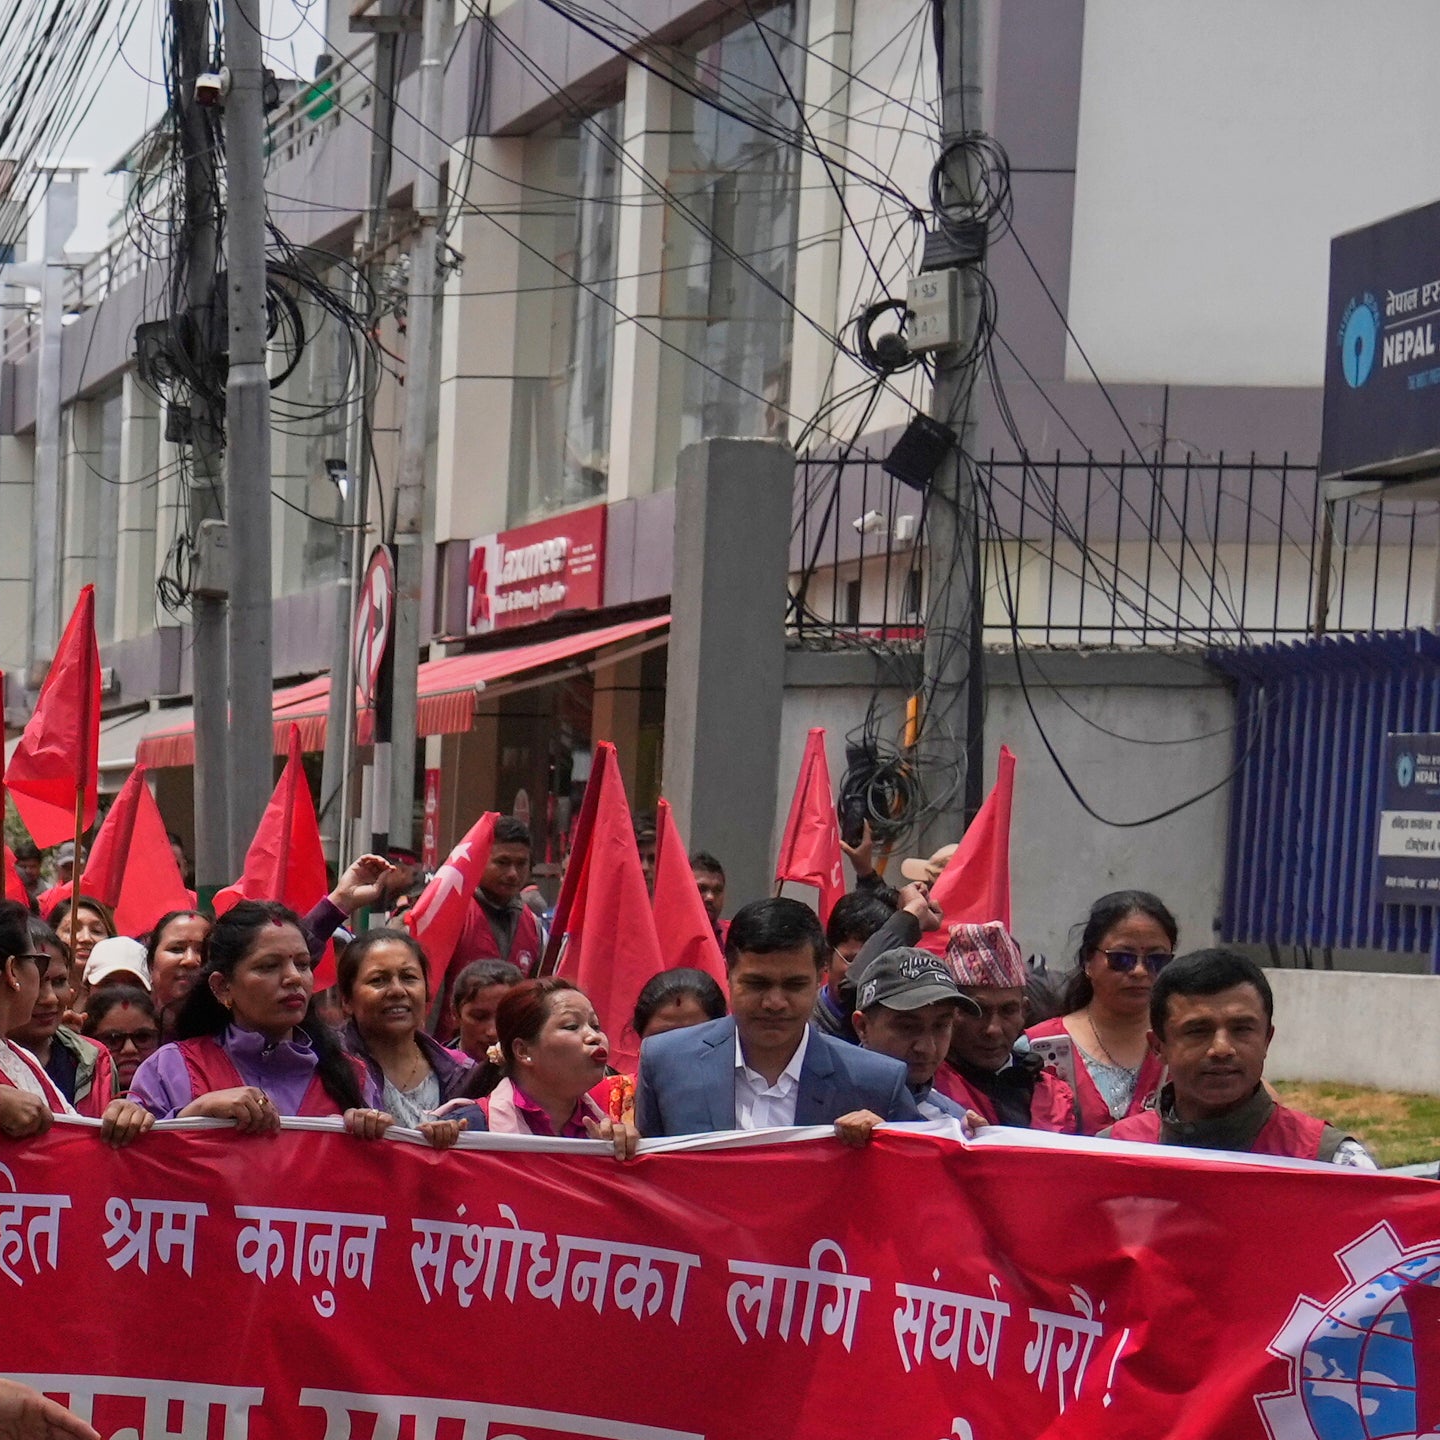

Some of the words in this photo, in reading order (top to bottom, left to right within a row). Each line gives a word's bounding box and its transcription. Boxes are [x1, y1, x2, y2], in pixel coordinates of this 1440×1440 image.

[1383, 323, 1434, 368] NEPAL
[101, 1196, 208, 1279] श्रम
[234, 1203, 387, 1319] कानुन
[411, 1203, 701, 1327] संशोधनका
[726, 1238, 870, 1353] लागि
[891, 1267, 1010, 1380] संघर्ष
